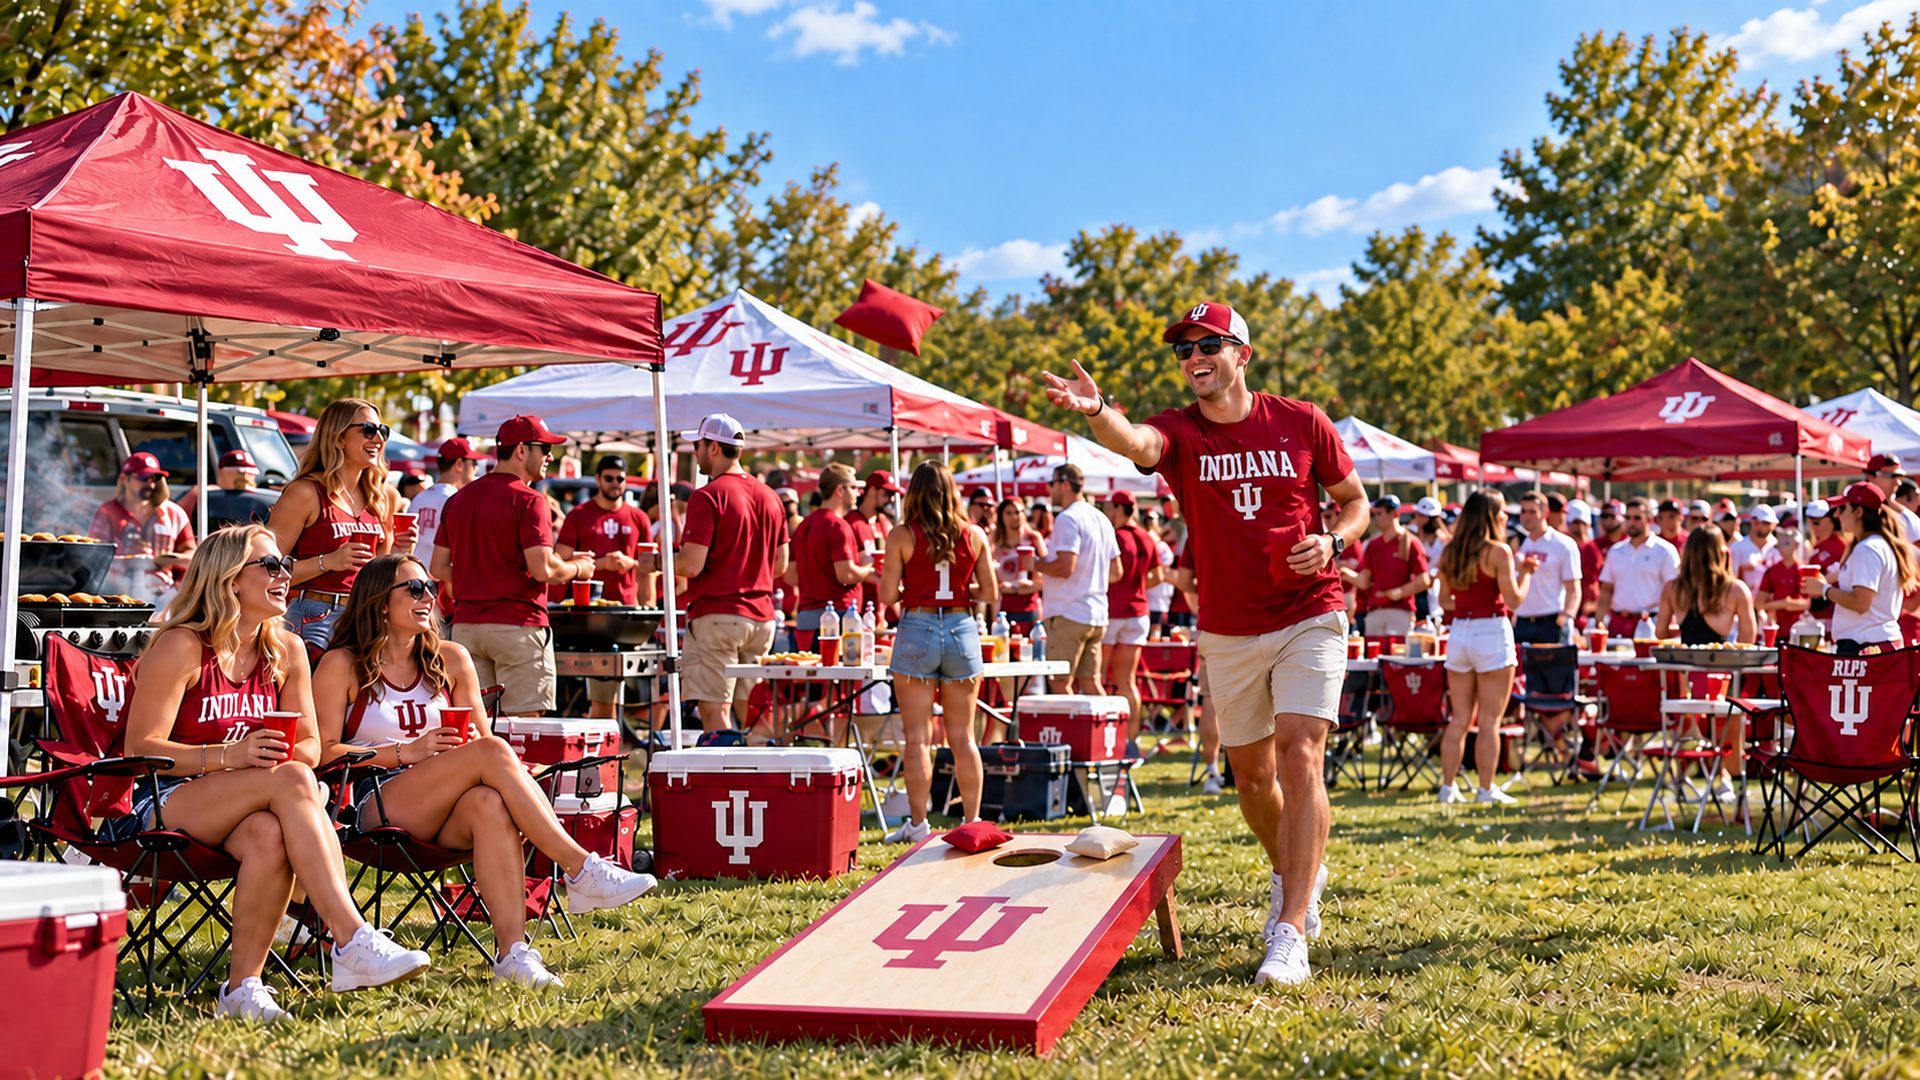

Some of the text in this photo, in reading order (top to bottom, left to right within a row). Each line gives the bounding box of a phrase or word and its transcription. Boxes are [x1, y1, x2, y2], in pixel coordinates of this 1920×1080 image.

[161, 147, 360, 262] IU
[729, 342, 790, 386] IU
[1658, 391, 1716, 424] IU
[1200, 450, 1297, 481] INDIANA
[1232, 483, 1262, 520] IU
[935, 560, 953, 599] 1
[198, 693, 275, 723] INDIANA
[394, 699, 427, 738] IU
[1828, 679, 1872, 735] IU
[712, 790, 768, 865] IU
[872, 896, 1048, 969] IU
